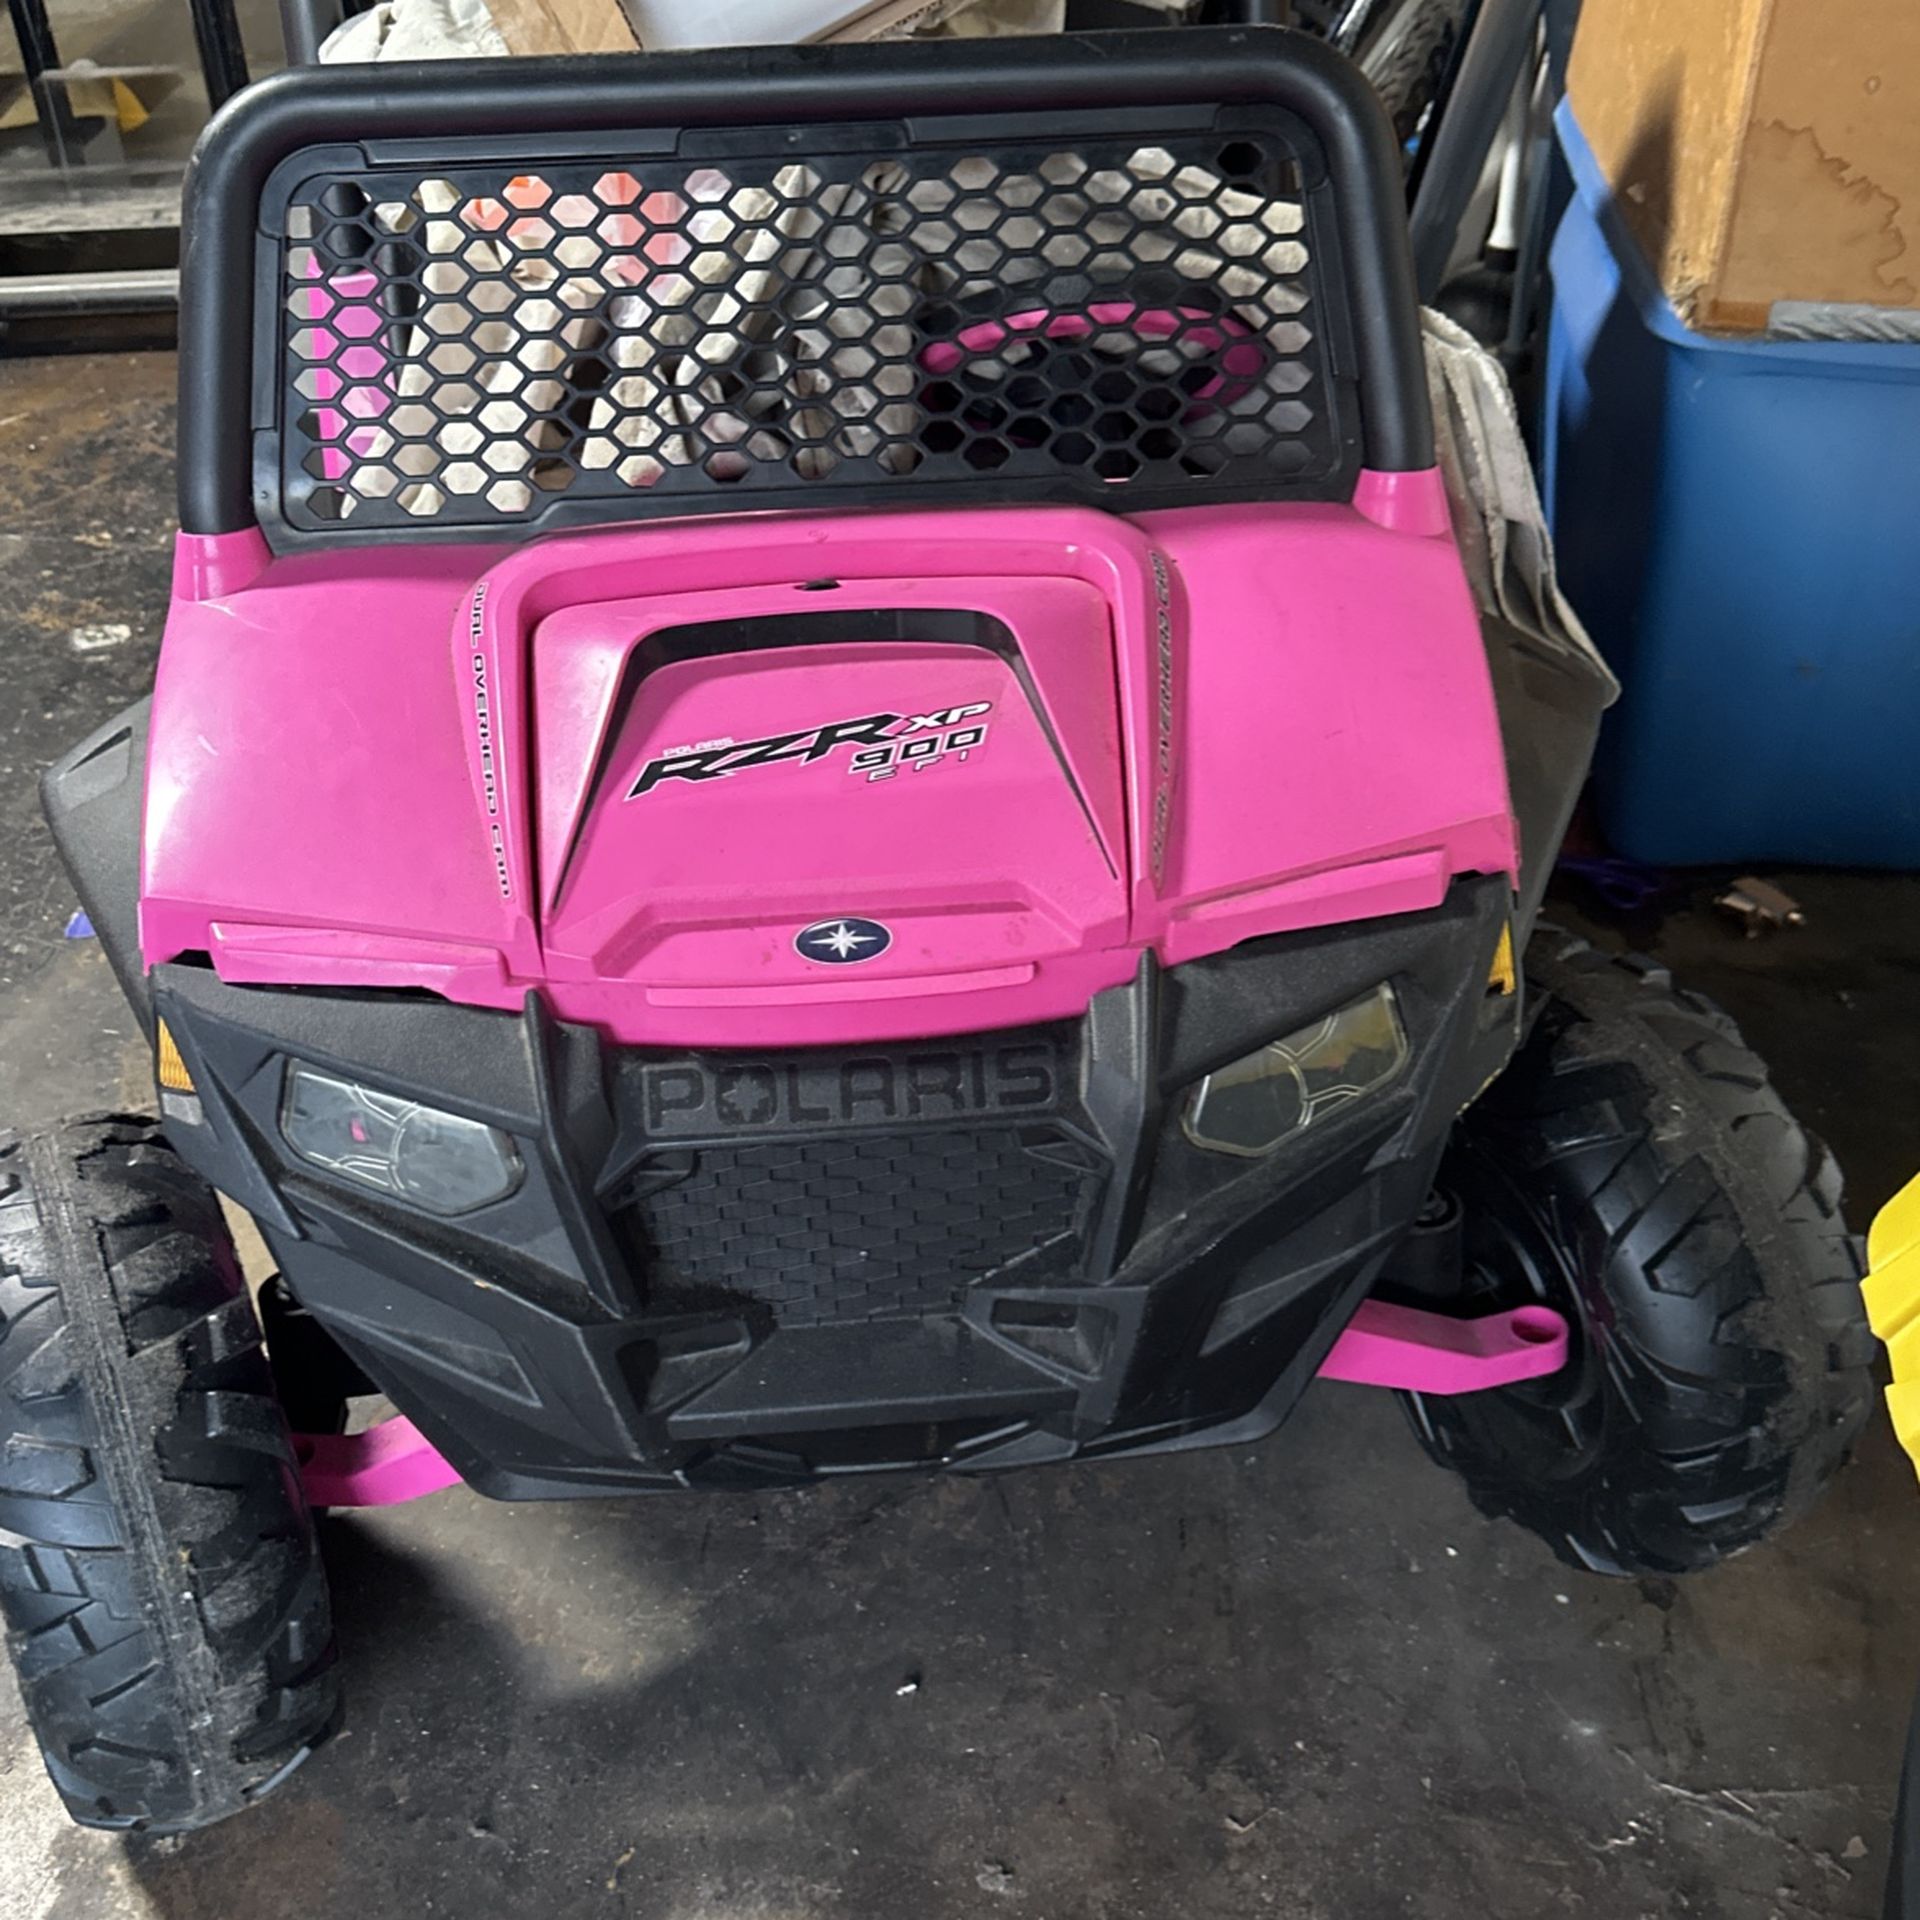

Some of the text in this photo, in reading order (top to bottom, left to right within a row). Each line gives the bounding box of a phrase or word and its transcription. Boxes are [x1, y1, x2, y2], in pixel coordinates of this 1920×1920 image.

[471, 583, 509, 897] DUAL OVERHEAD CAM
[624, 701, 992, 801] RZR XP
[663, 736, 735, 758] POLARIS
[848, 723, 988, 774] 900
[865, 750, 968, 783] EFI
[648, 1047, 1054, 1130] POLARIS
